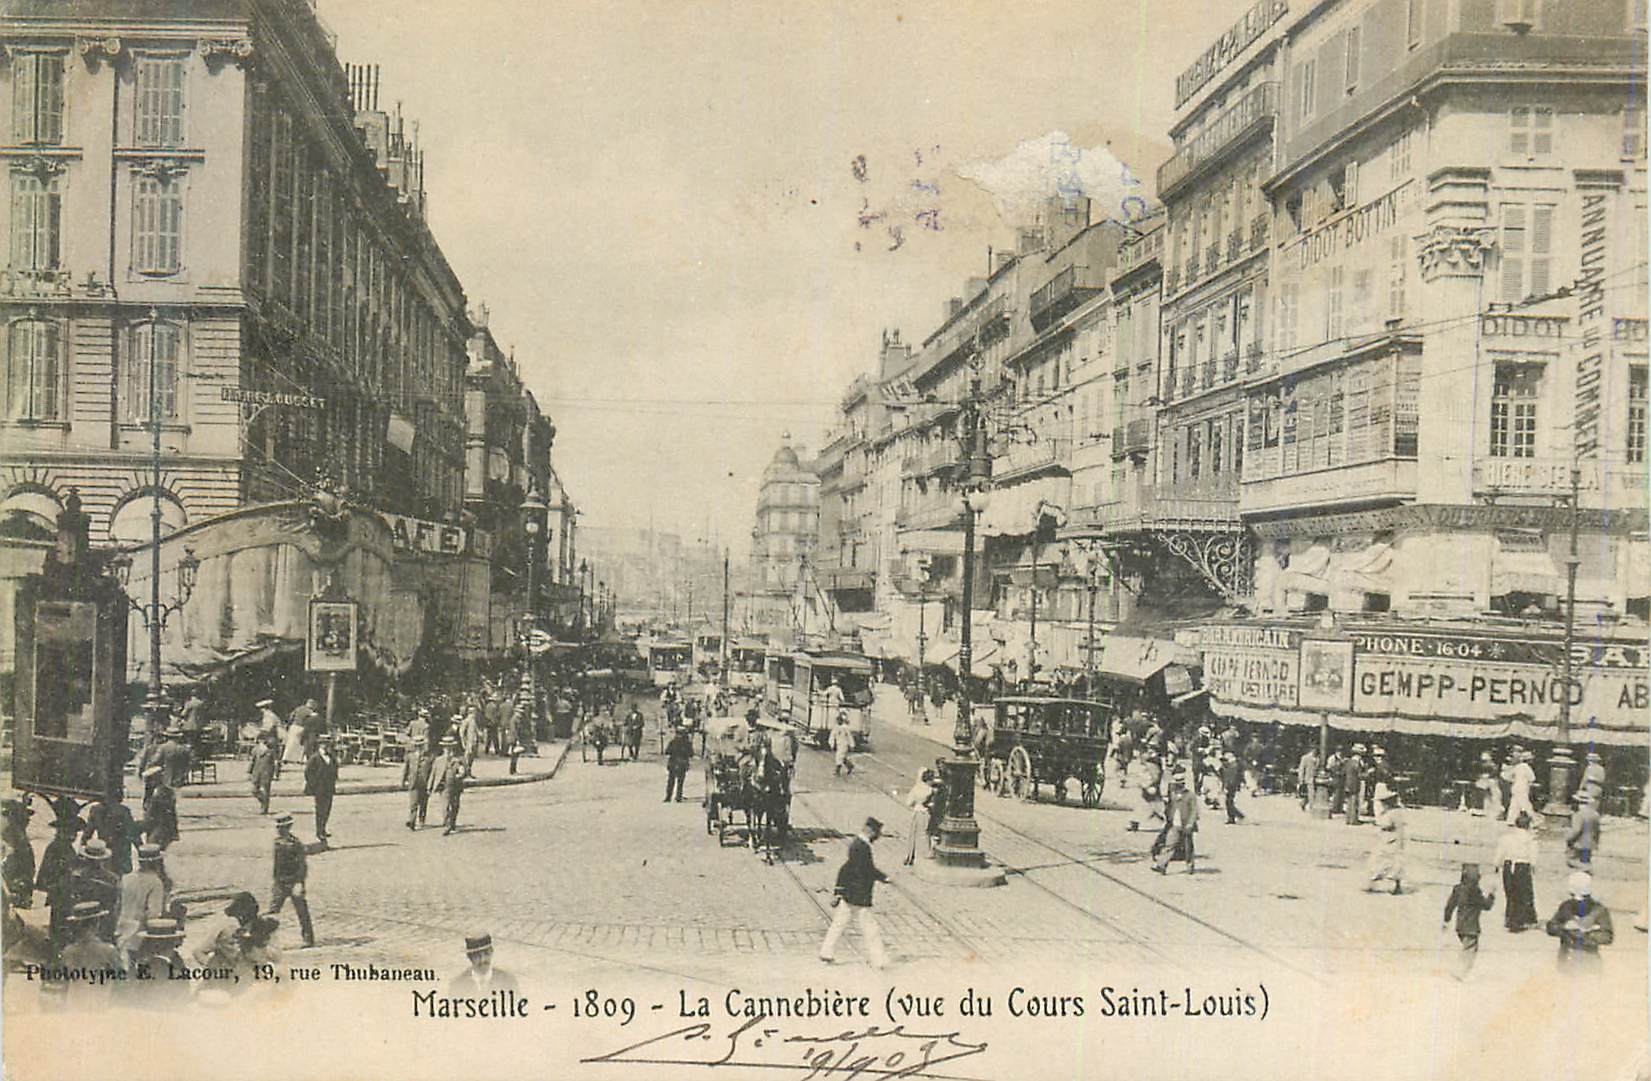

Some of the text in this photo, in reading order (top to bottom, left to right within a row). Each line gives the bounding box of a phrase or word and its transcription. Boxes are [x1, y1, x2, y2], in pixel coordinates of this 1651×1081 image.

[1482, 317, 1564, 338] DIDOT
[1355, 637, 1425, 655] PHONE
[1360, 670, 1582, 706] GEMPP-PERNOD
